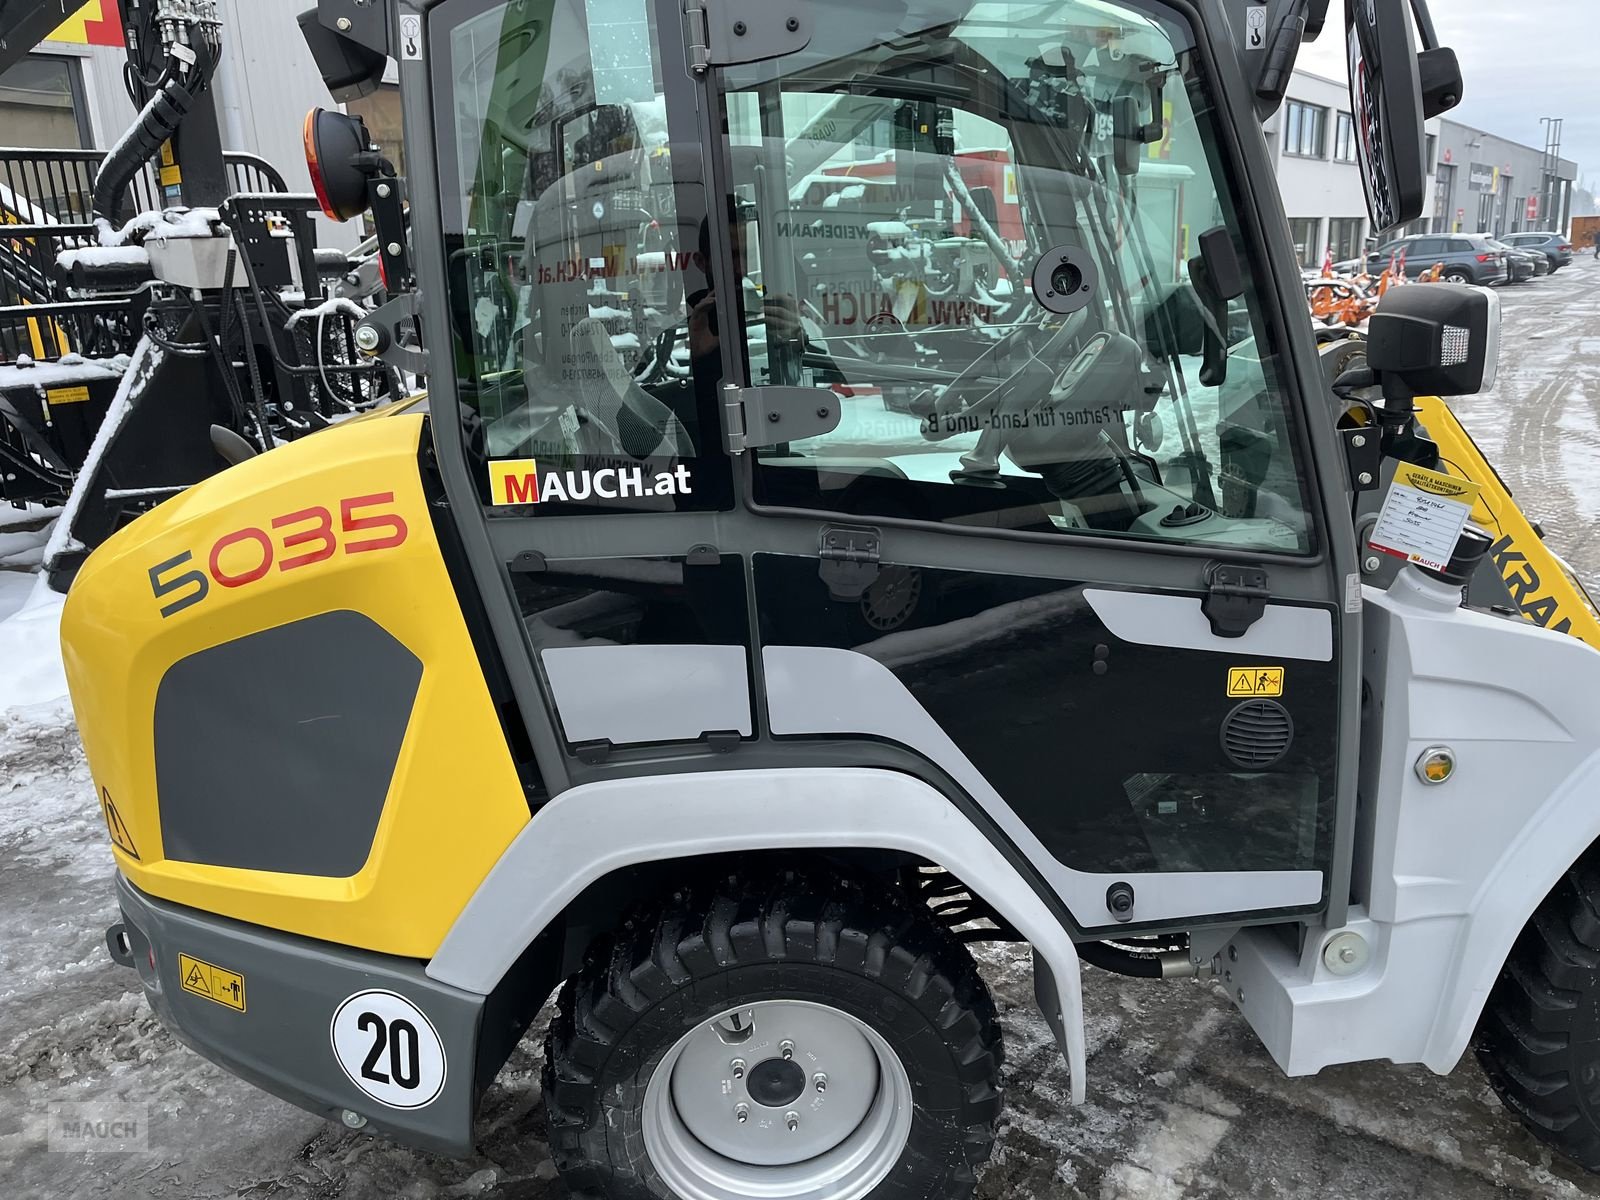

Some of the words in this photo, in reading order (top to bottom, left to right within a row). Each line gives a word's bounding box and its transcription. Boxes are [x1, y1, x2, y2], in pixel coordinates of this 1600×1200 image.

[504, 464, 692, 503] MAUCH.at
[148, 491, 408, 618] 5035
[1412, 554, 1440, 570] MAUCH
[357, 1010, 420, 1090] 20
